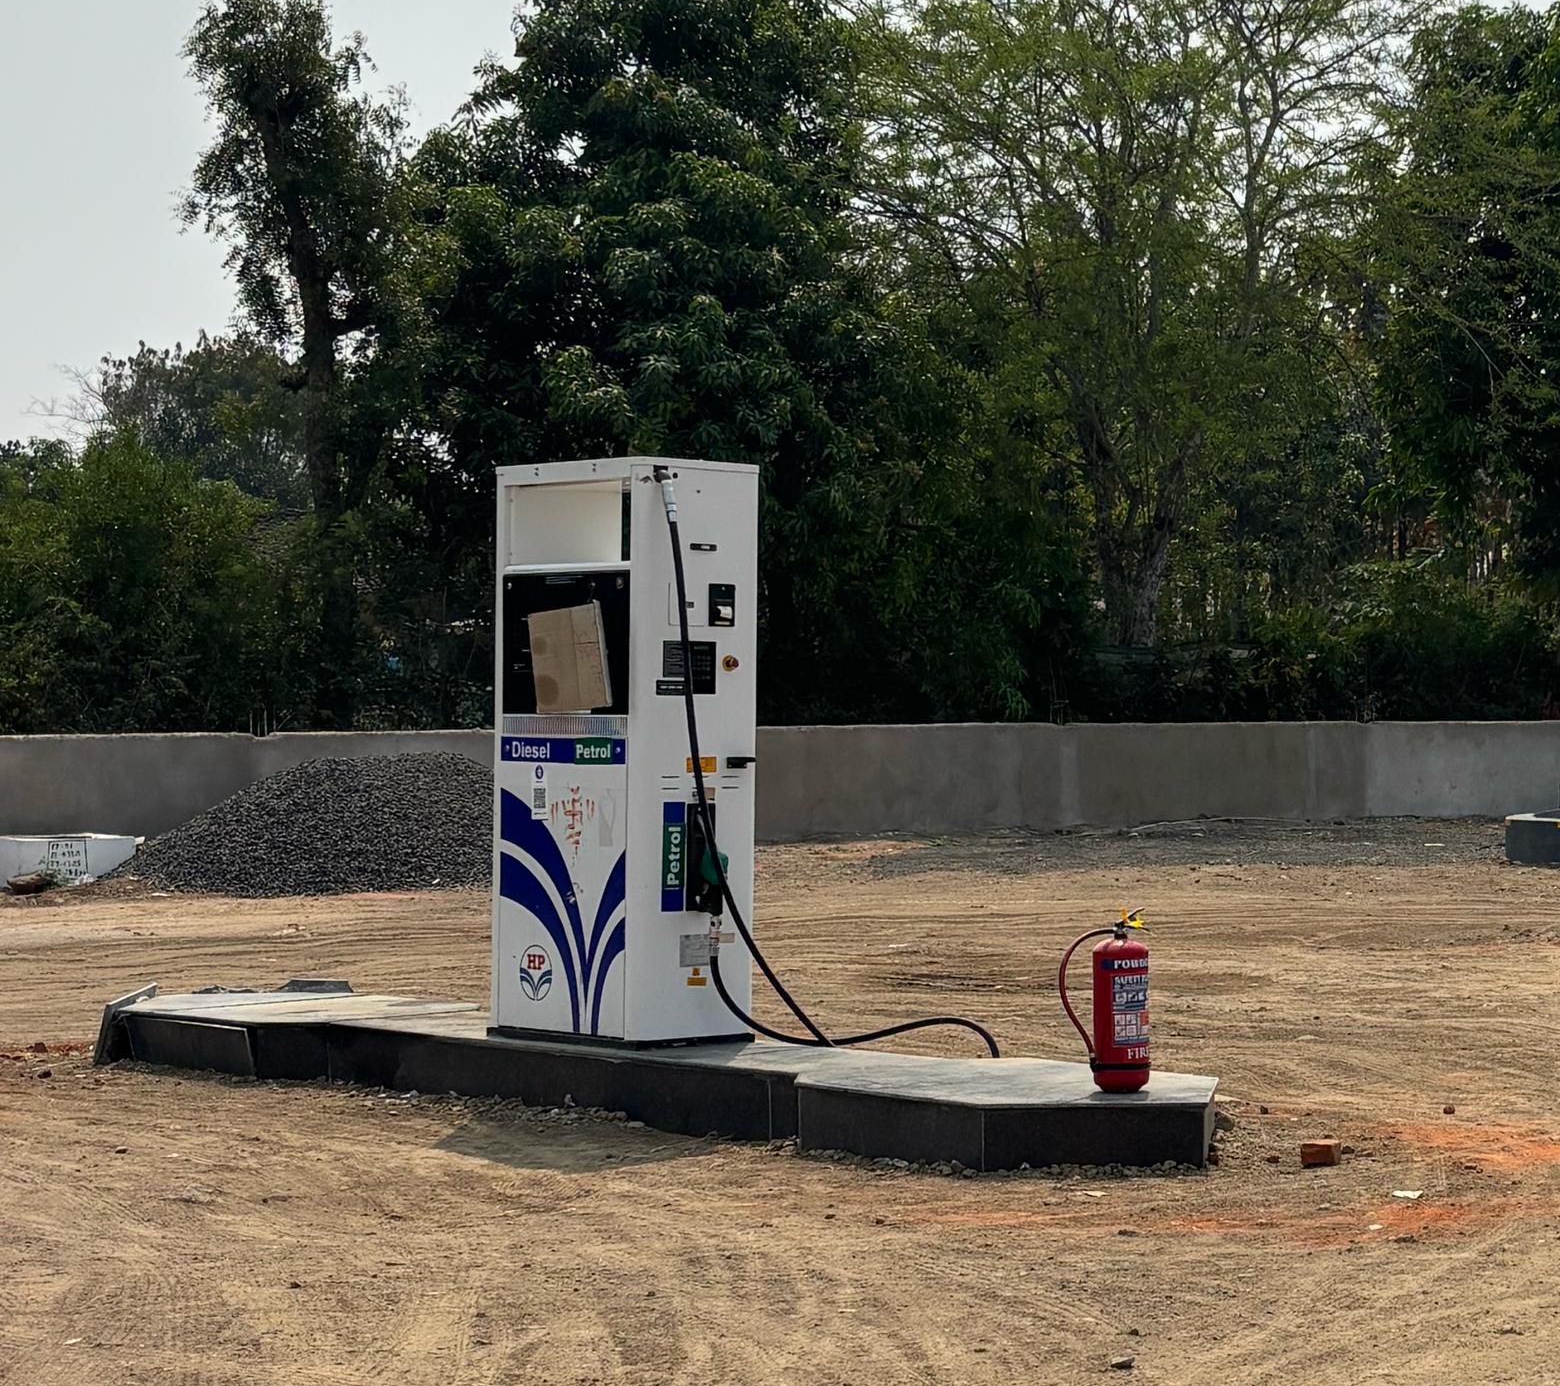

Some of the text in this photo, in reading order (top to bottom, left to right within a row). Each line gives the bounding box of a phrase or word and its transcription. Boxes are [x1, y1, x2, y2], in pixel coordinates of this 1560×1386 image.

[512, 741, 611, 759] Diesel Petrol
[666, 825, 681, 885] Petrol
[526, 953, 545, 970] HP
